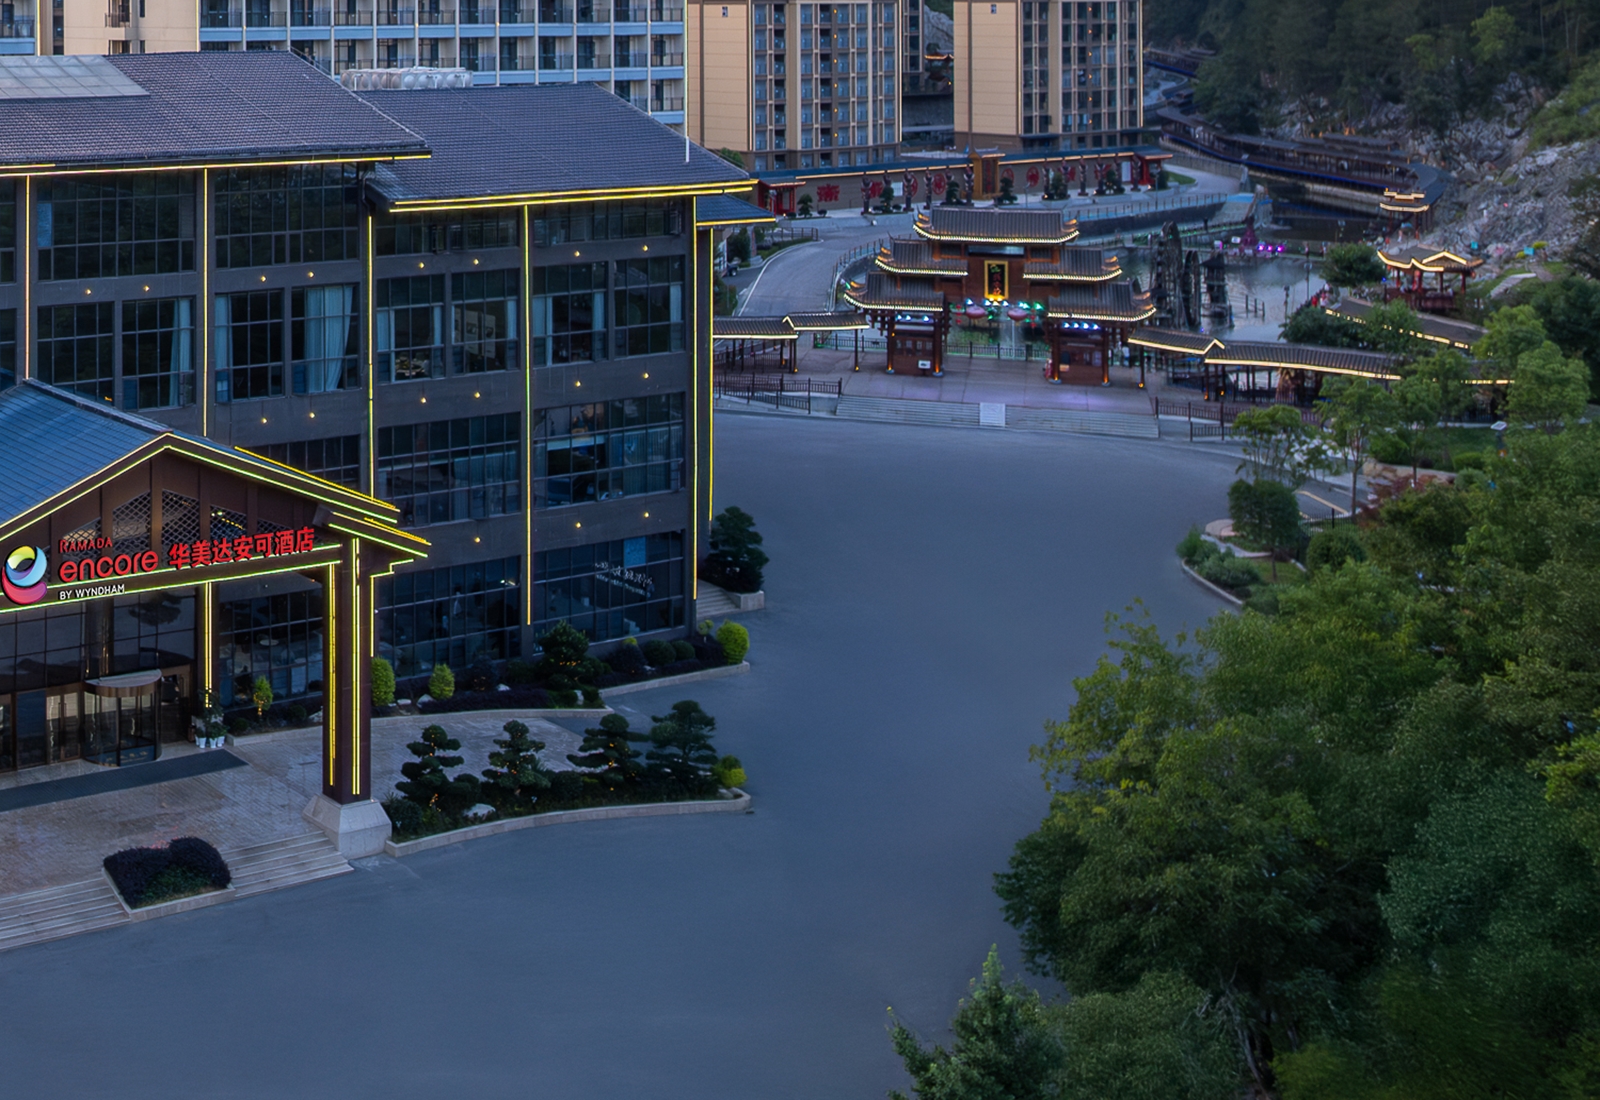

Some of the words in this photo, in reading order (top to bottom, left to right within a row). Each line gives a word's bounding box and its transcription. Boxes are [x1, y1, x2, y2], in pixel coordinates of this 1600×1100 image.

[59, 536, 113, 554] RAMADA
[169, 526, 315, 570] 华美达安可酒店
[59, 550, 159, 583] encore
[59, 590, 72, 600] BY
[75, 583, 125, 598] WYNDHAM
